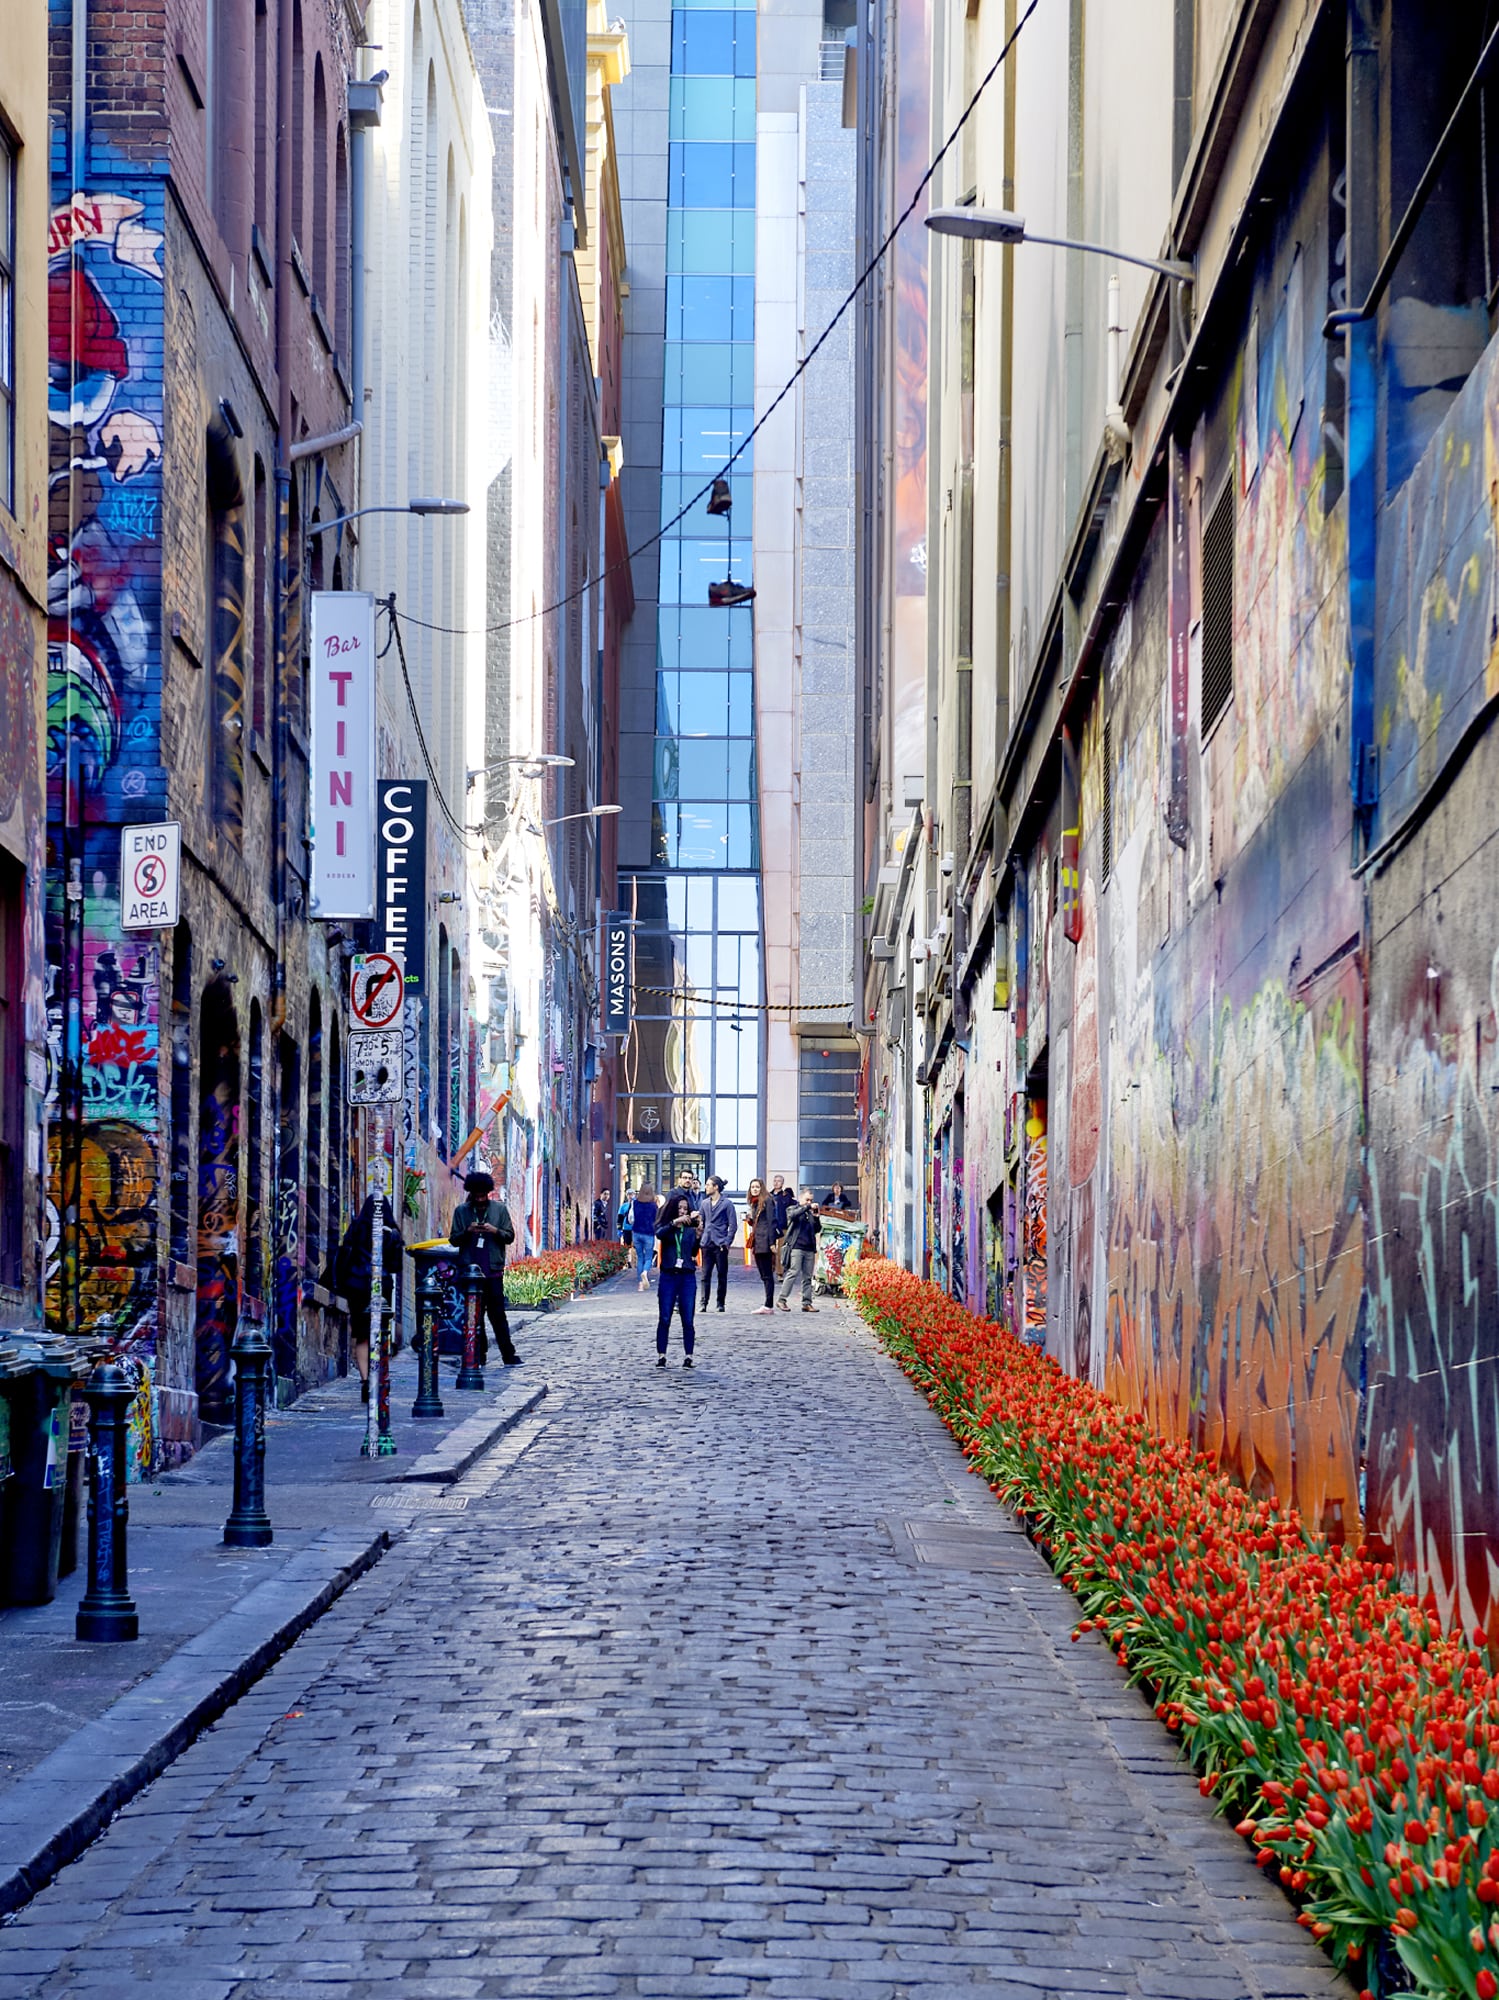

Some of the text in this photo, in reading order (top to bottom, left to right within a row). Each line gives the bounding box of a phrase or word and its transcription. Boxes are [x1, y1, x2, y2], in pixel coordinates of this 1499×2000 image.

[324, 635, 361, 658] Bar
[329, 672, 353, 858] TINI
[134, 834, 167, 853] END
[142, 863, 158, 892] S
[381, 786, 415, 962] COFFEE
[129, 901, 169, 920] AREA
[611, 930, 626, 1015] MASONS
[381, 1039, 390, 1056] 5
